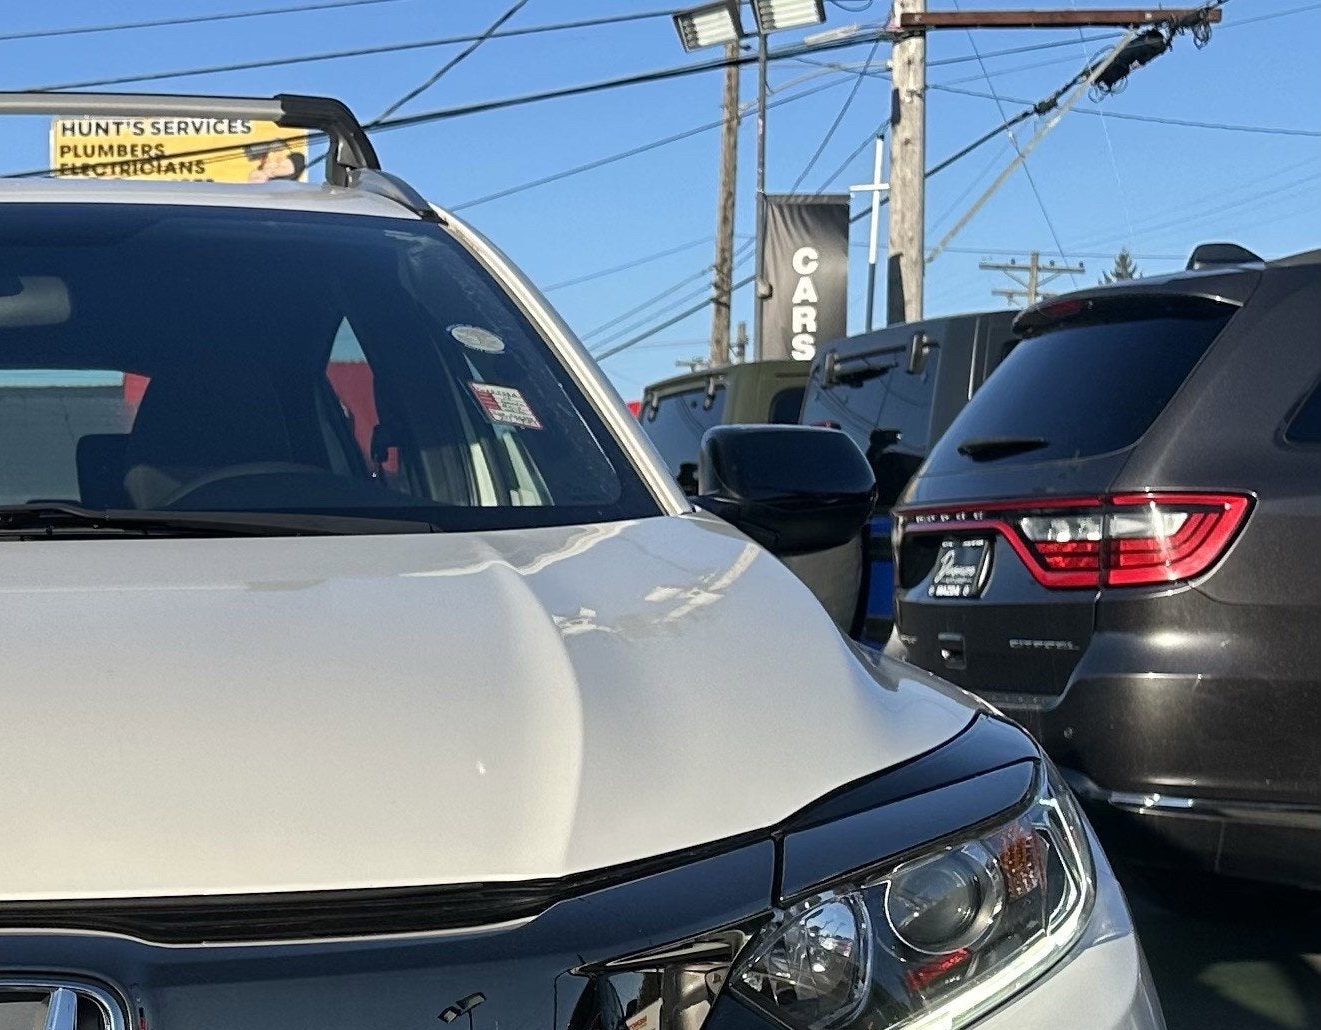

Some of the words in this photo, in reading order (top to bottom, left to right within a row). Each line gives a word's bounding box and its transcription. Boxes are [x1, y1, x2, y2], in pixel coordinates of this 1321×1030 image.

[61, 121, 145, 137] HUNT'S
[150, 120, 252, 136] SERVICES
[59, 143, 165, 158] PLUMBERS
[60, 159, 205, 176] ELECTRICIANS
[791, 246, 819, 361] CARS
